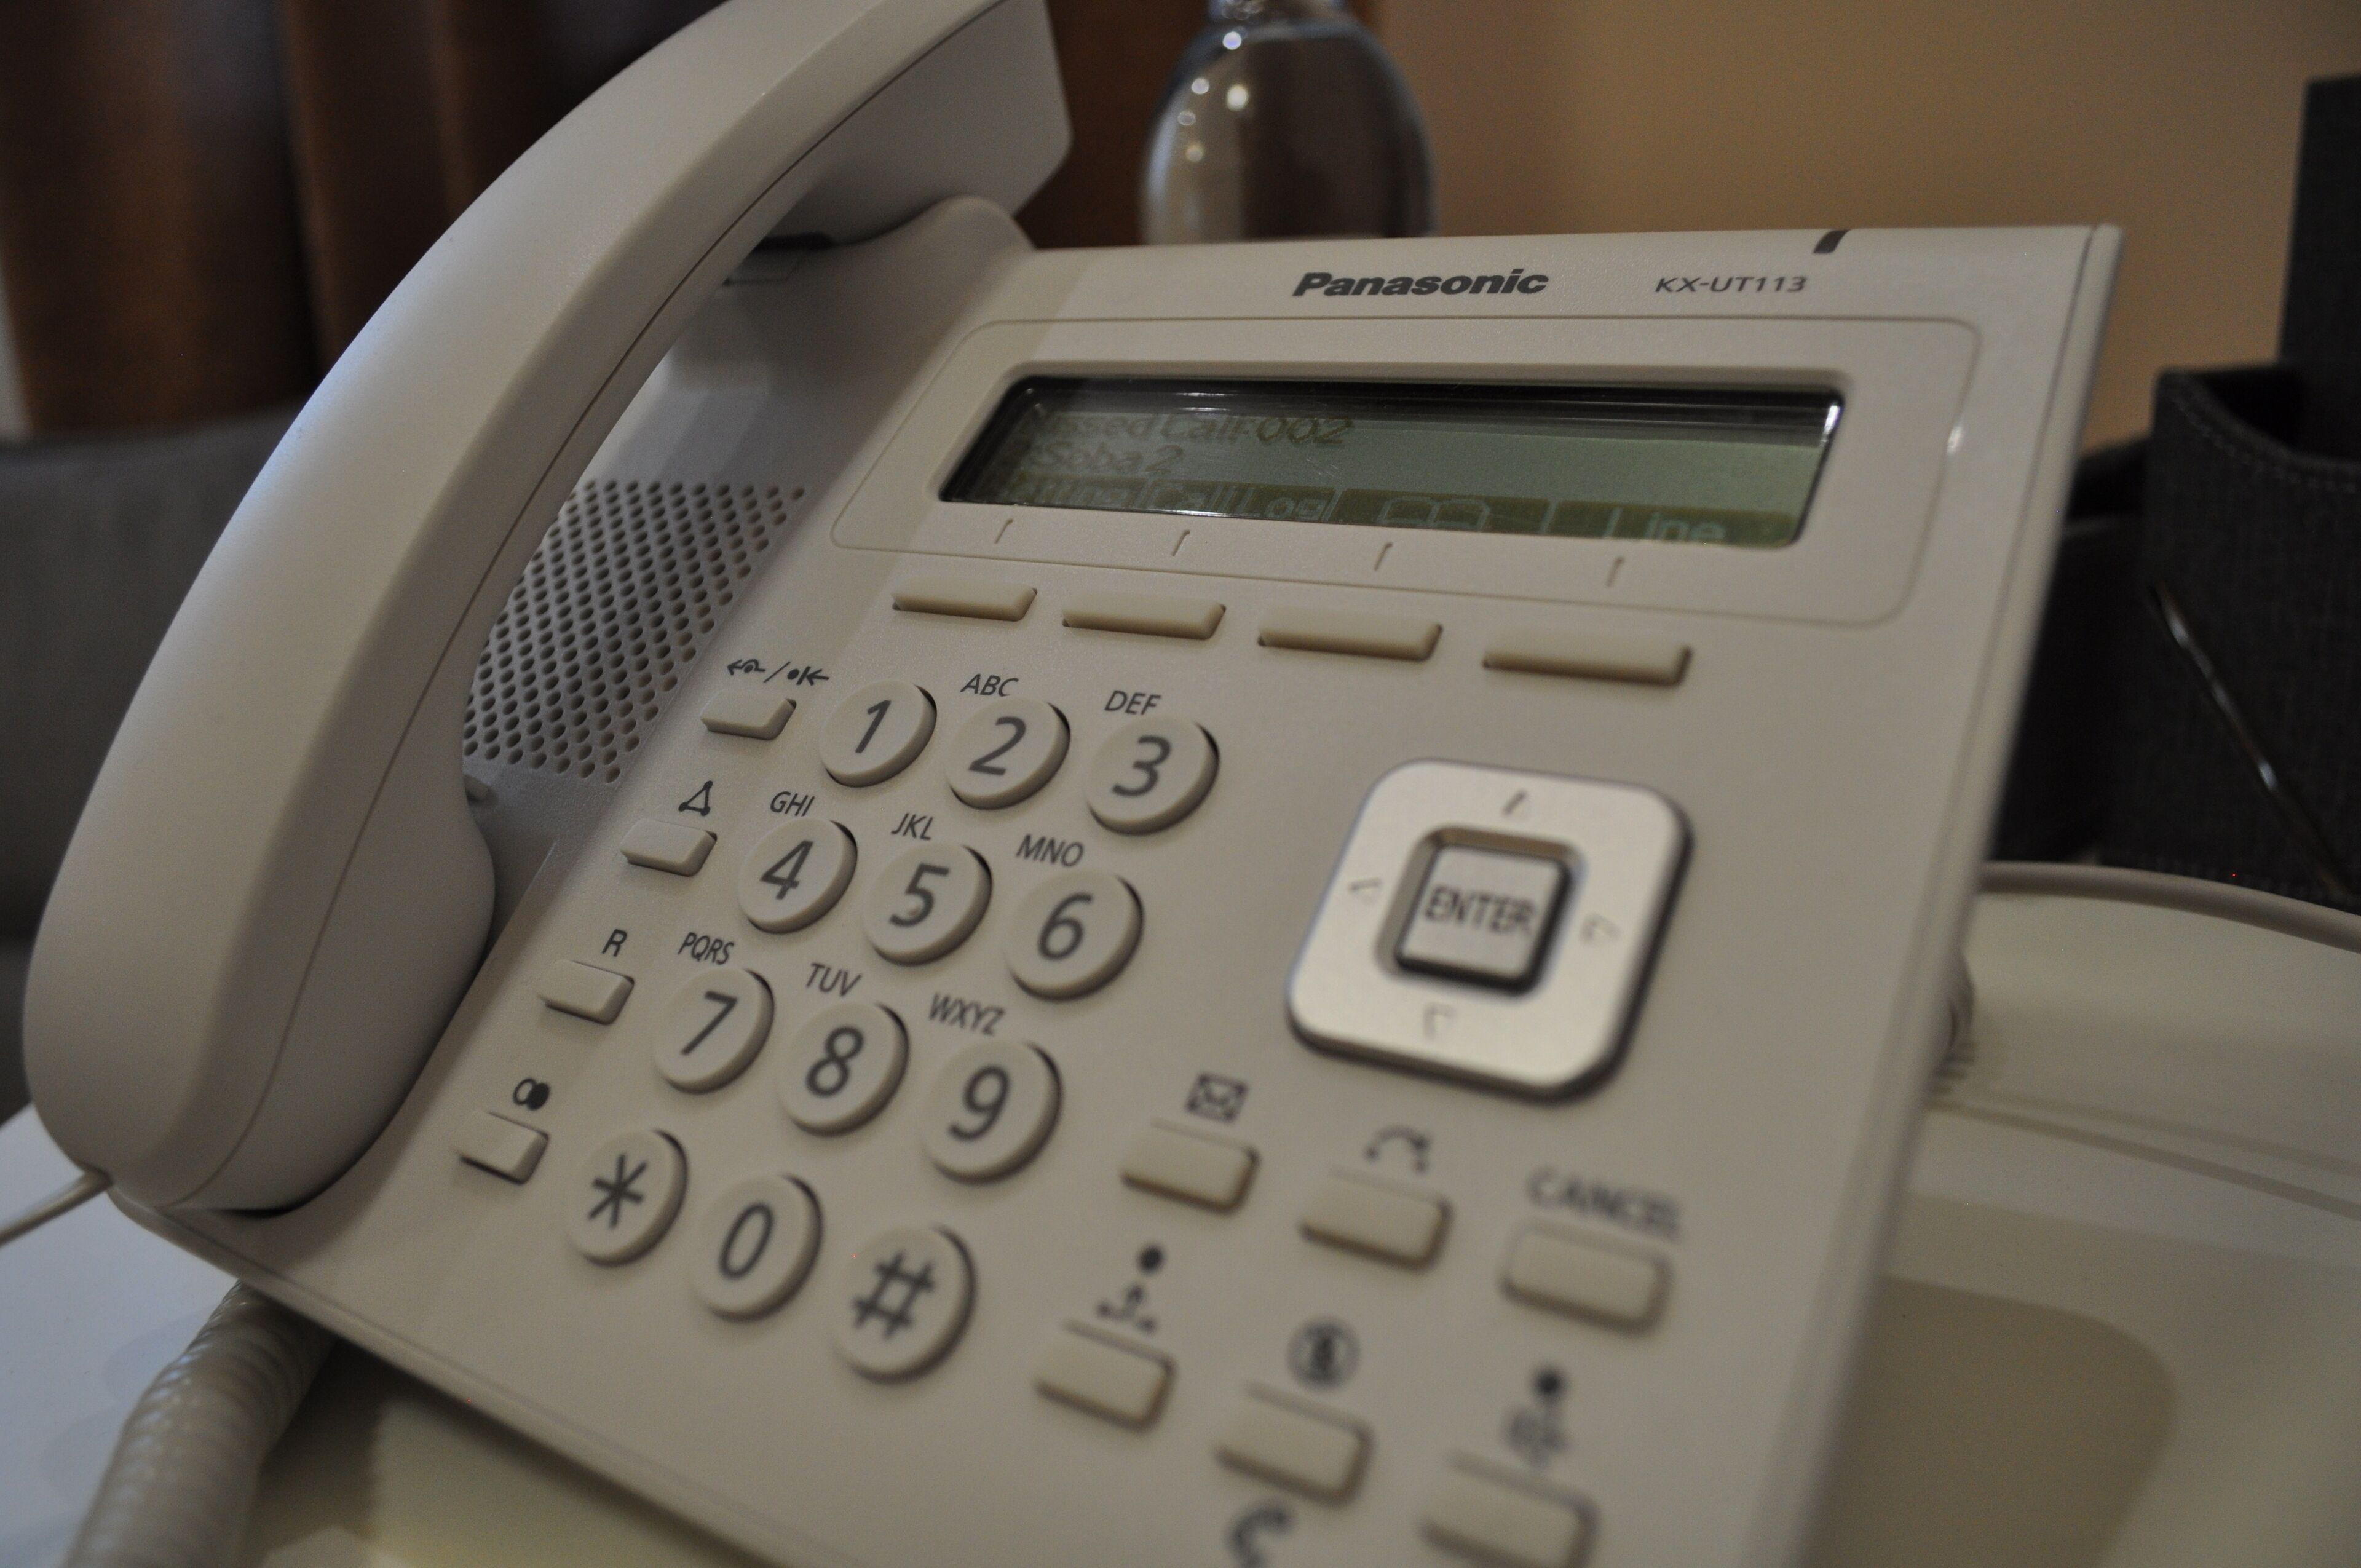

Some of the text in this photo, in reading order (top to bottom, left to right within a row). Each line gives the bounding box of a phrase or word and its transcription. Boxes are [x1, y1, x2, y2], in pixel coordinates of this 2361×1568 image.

[1292, 268, 1549, 296] Panasonic
[1655, 275, 1808, 293] KX-UT113
[1144, 444, 1184, 473] 2
[960, 673, 1019, 697] ABC
[1104, 689, 1161, 716] DEF
[854, 699, 892, 755] 1
[968, 715, 1026, 777] 2
[1110, 735, 1173, 798] 3
[769, 791, 815, 817] GHI
[891, 812, 934, 841] JKL
[760, 840, 815, 901] 4
[1016, 834, 1085, 866] MNO
[889, 863, 951, 927] 5
[1423, 885, 1537, 937] ENTER
[602, 929, 628, 957] R
[678, 931, 735, 965] PQRS
[1037, 892, 1094, 961] 6
[805, 962, 863, 997] TUV
[680, 989, 737, 1056] 7
[928, 993, 1006, 1037] WXYZ
[804, 1025, 864, 1098] 8
[947, 1065, 1011, 1141] 9
[719, 1202, 775, 1280] 0
